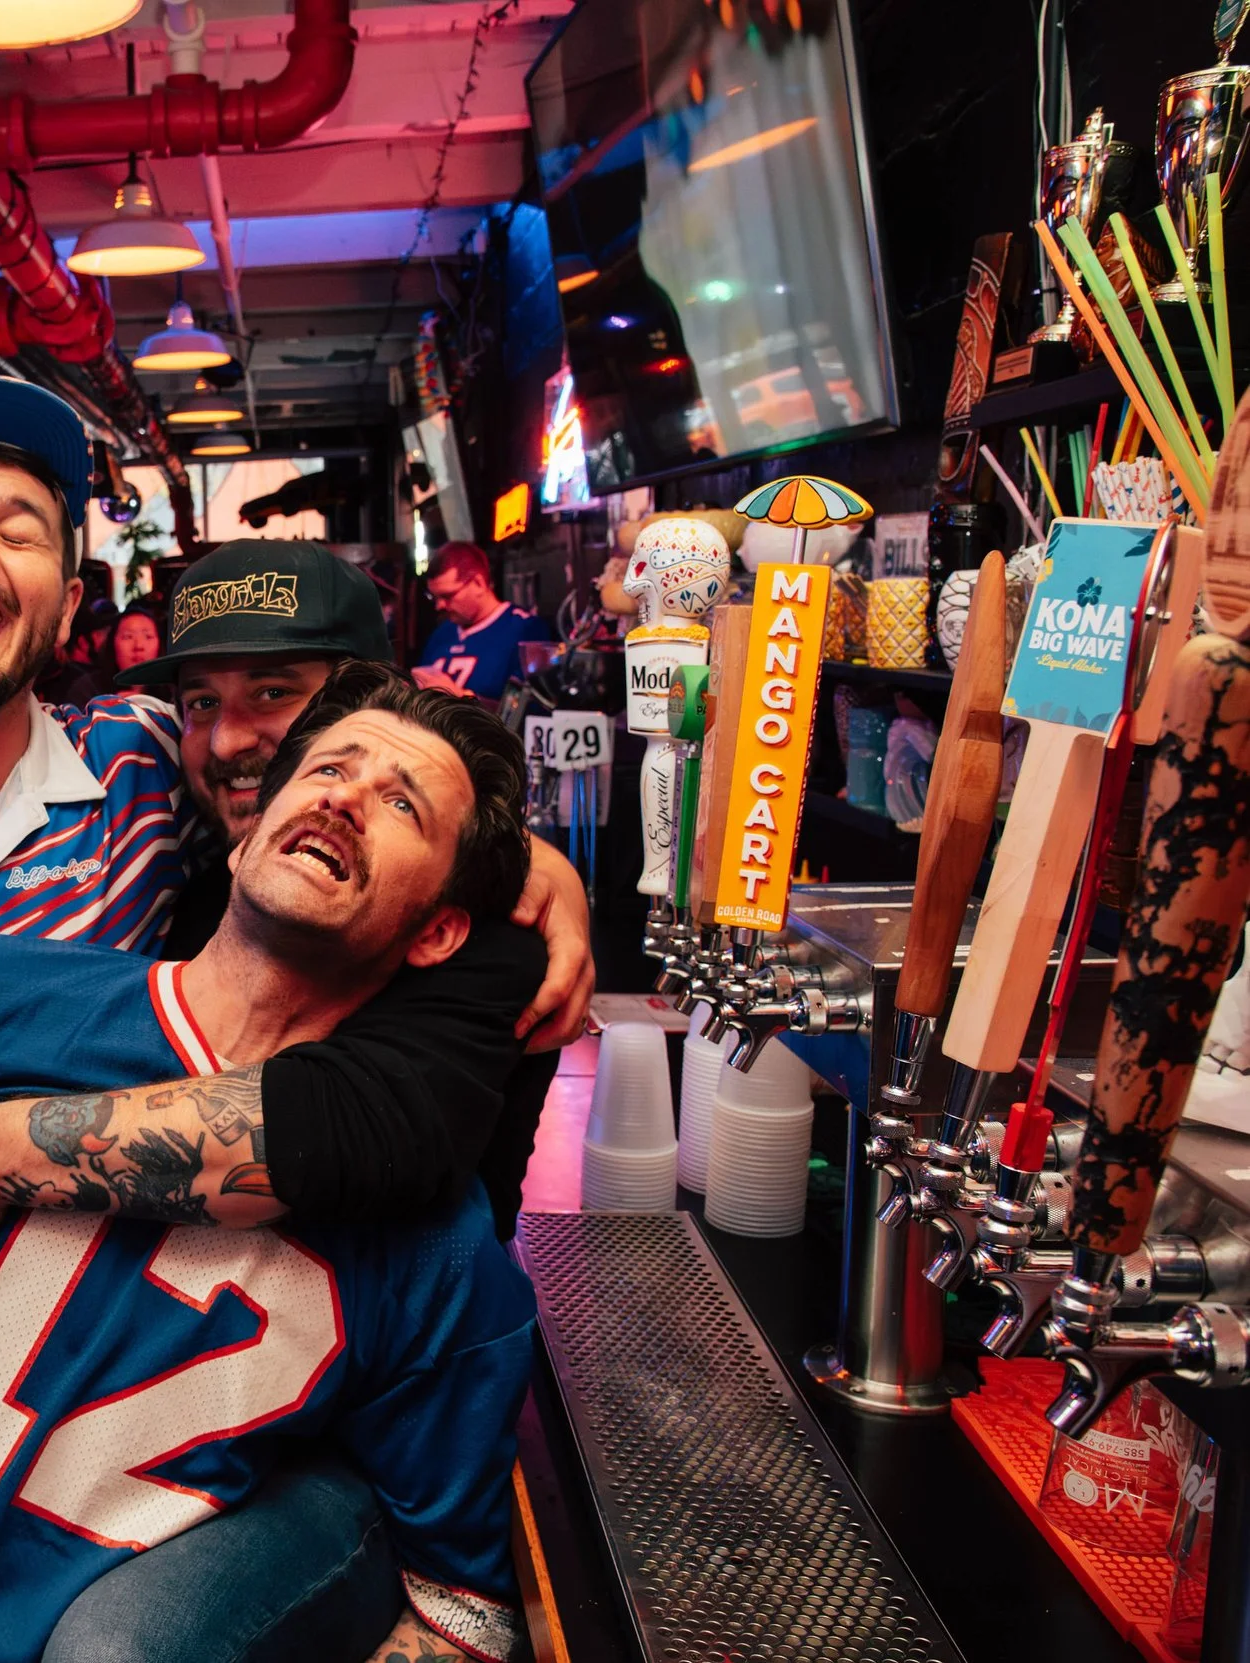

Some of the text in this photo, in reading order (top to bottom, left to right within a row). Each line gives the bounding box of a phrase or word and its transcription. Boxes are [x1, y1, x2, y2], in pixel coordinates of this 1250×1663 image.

[1035, 597, 1126, 638] KONA
[755, 570, 812, 747] MANGO
[1028, 629, 1125, 661] BIG WAVE
[631, 665, 670, 689] Mod
[562, 725, 601, 762] 29
[648, 766, 673, 855] Especial
[739, 763, 785, 902] CART
[717, 904, 782, 925] GOLDEN ROAD
[1083, 1435, 1145, 1458] 585-749-97
[1064, 1454, 1148, 1486] ELECTRICAL
